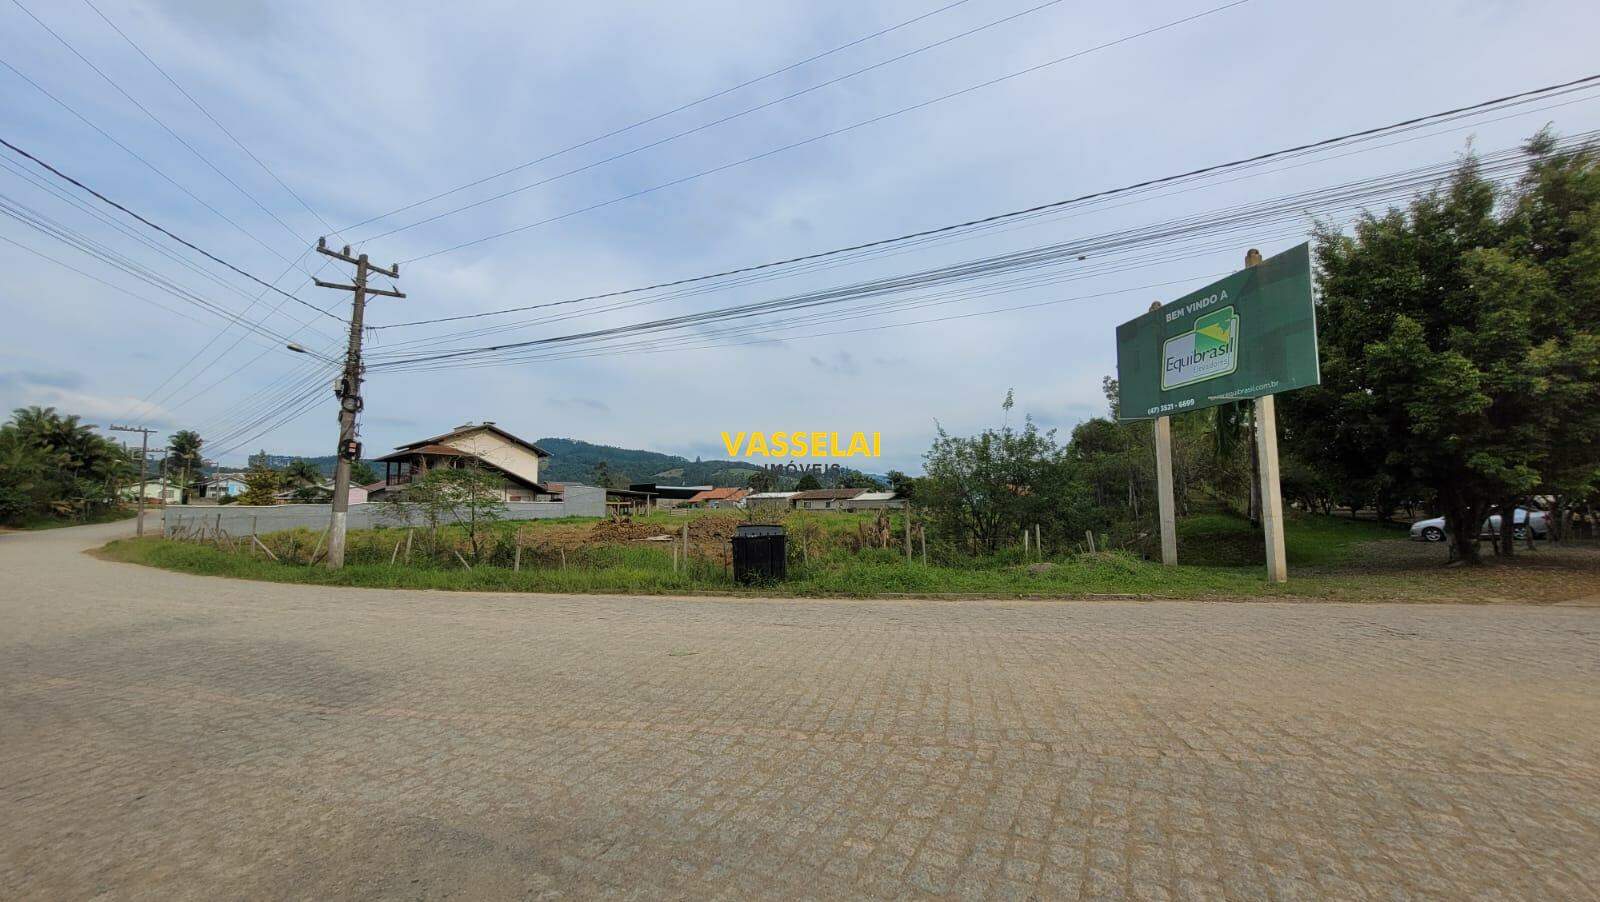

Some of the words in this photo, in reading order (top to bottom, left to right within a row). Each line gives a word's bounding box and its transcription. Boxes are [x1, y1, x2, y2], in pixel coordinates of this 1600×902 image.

[1166, 307, 1185, 322] BEM
[1186, 294, 1218, 314] VINDO
[1220, 290, 1229, 301] A
[1166, 337, 1233, 373] Equibrasil
